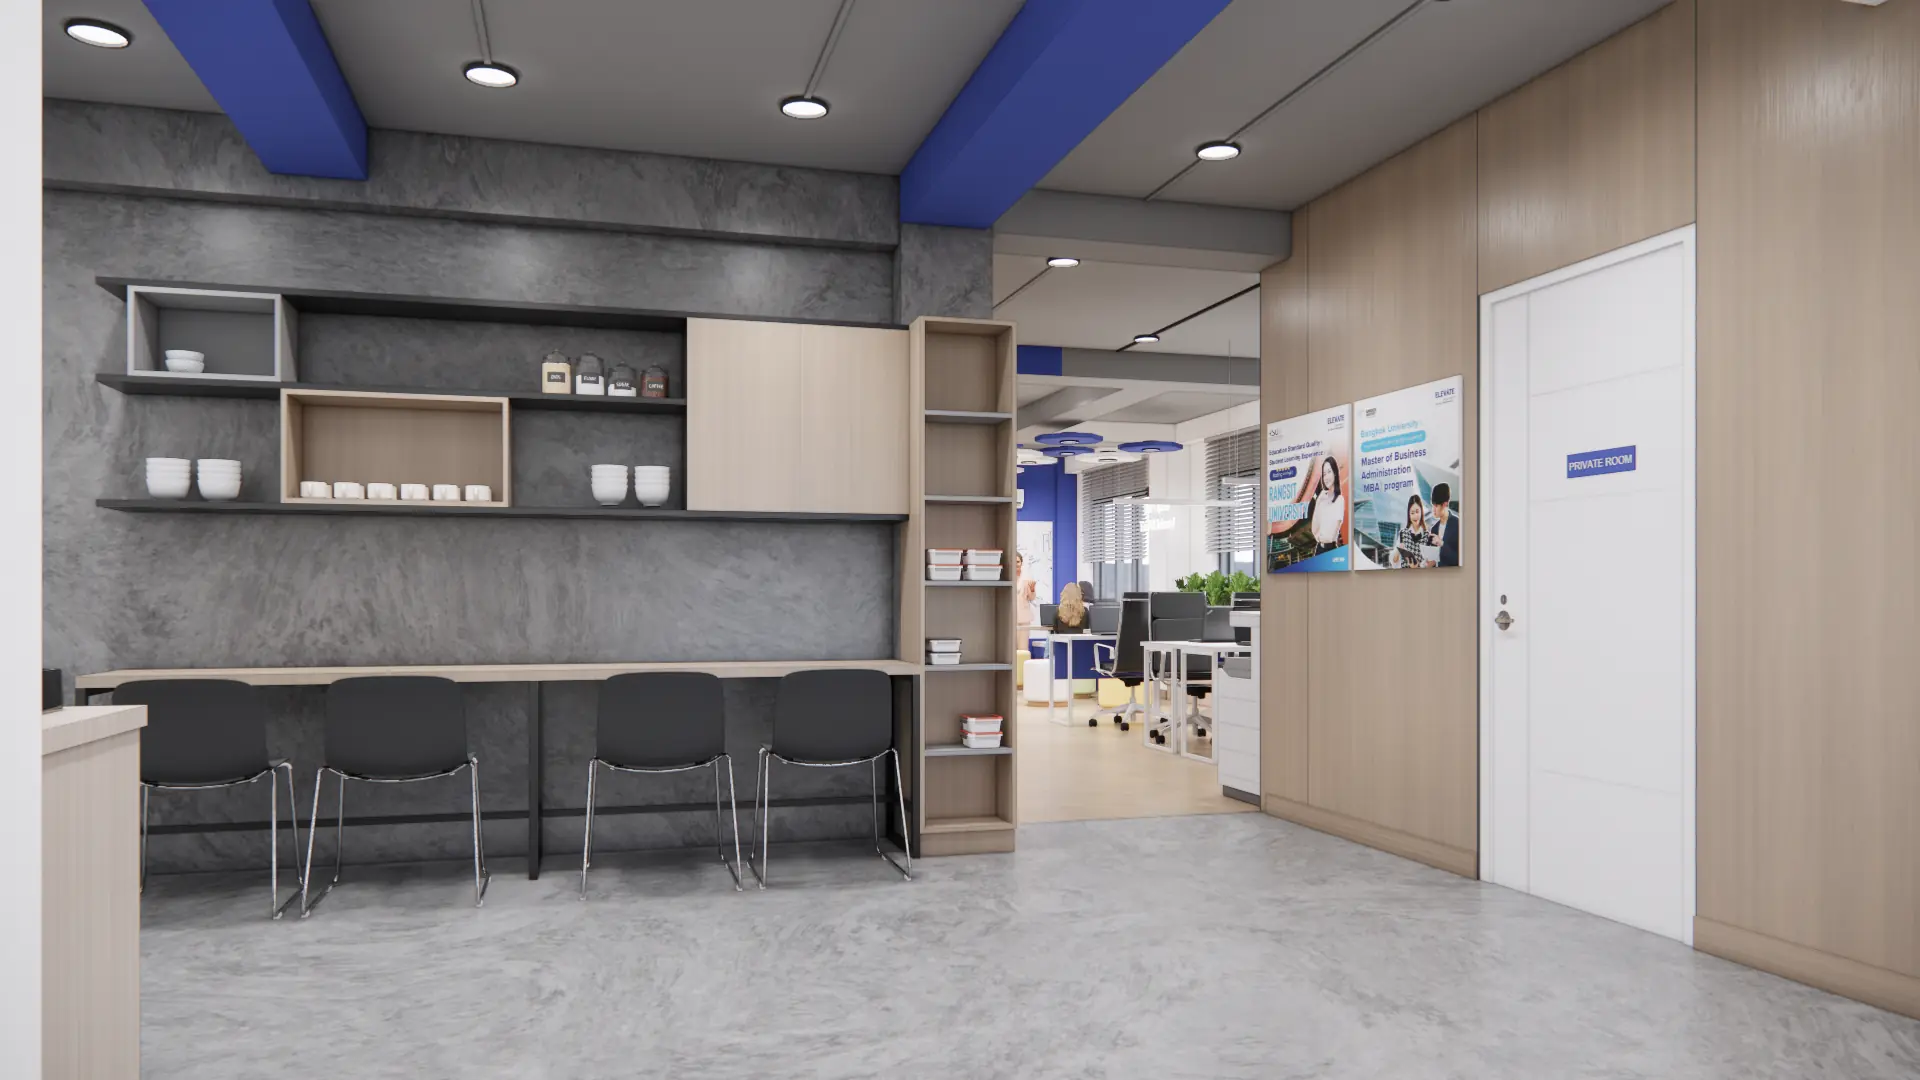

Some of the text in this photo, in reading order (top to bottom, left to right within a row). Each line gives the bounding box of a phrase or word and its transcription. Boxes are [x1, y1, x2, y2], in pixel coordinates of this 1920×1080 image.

[1361, 448, 1427, 467] Master of Business
[1568, 454, 1633, 471] PRIVATE ROOM
[1361, 464, 1412, 480] Administration
[1269, 482, 1297, 502] RANGSIT
[1383, 479, 1414, 493] program
[1268, 503, 1308, 523] UNIVERSITY
